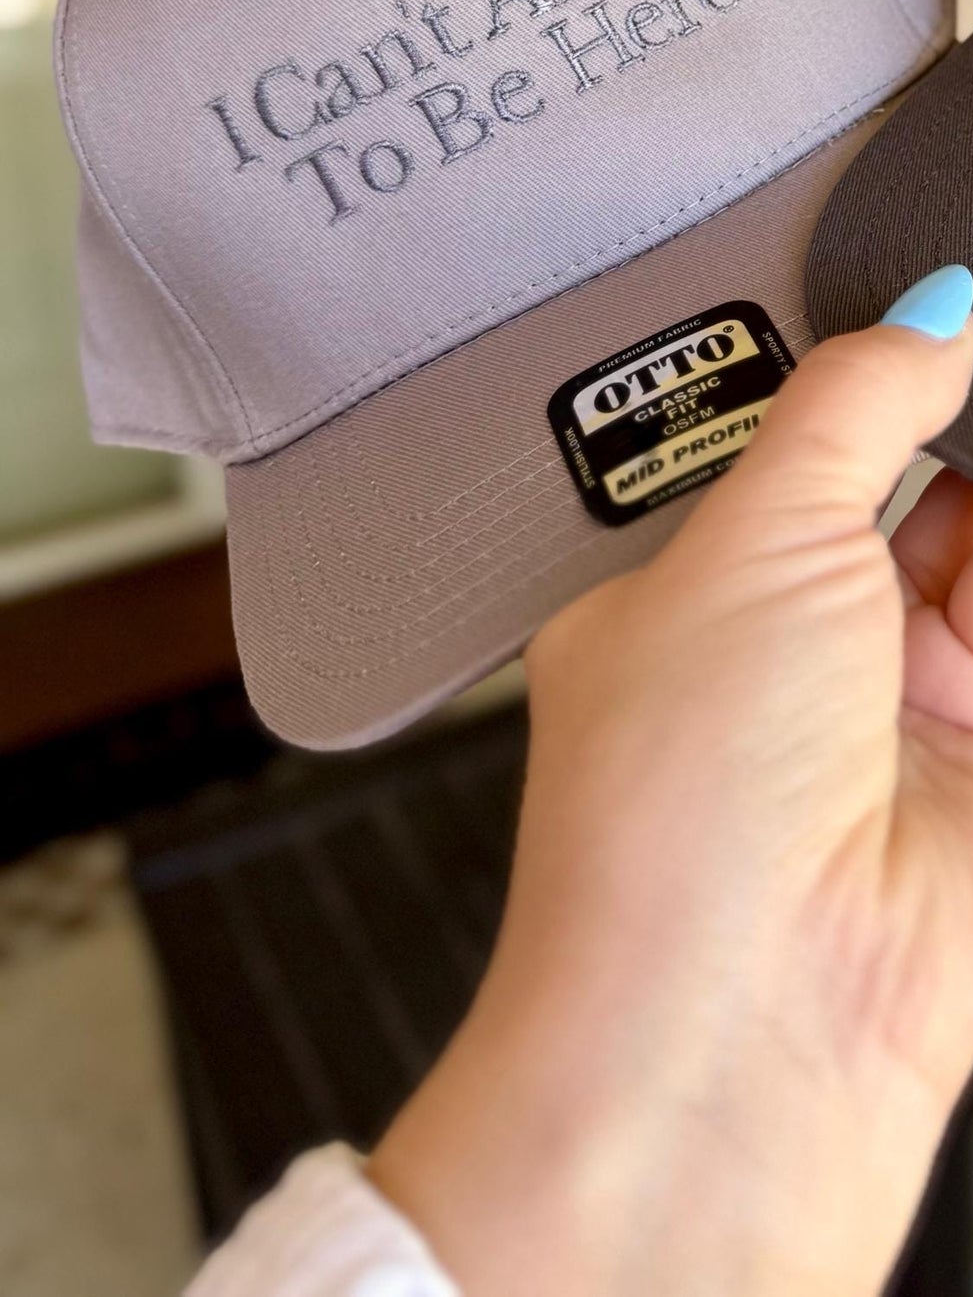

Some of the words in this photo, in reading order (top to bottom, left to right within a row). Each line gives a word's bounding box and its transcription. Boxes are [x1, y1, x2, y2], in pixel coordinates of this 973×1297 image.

[206, 95, 264, 174] I
[253, 0, 474, 142] Can't
[284, 139, 415, 227] To
[410, 68, 546, 168] Be
[598, 340, 655, 373] PREMIUM
[657, 318, 703, 343] FABRIC
[762, 331, 787, 363] SPORTY
[593, 333, 735, 414] OTTO
[634, 376, 722, 423] CLASSIC
[663, 406, 716, 436] OSFM
[666, 397, 698, 420] FIT
[564, 426, 581, 452] LOOK
[615, 456, 665, 496] MID
[672, 413, 760, 465] PROFI
[573, 450, 596, 489] STYLISH
